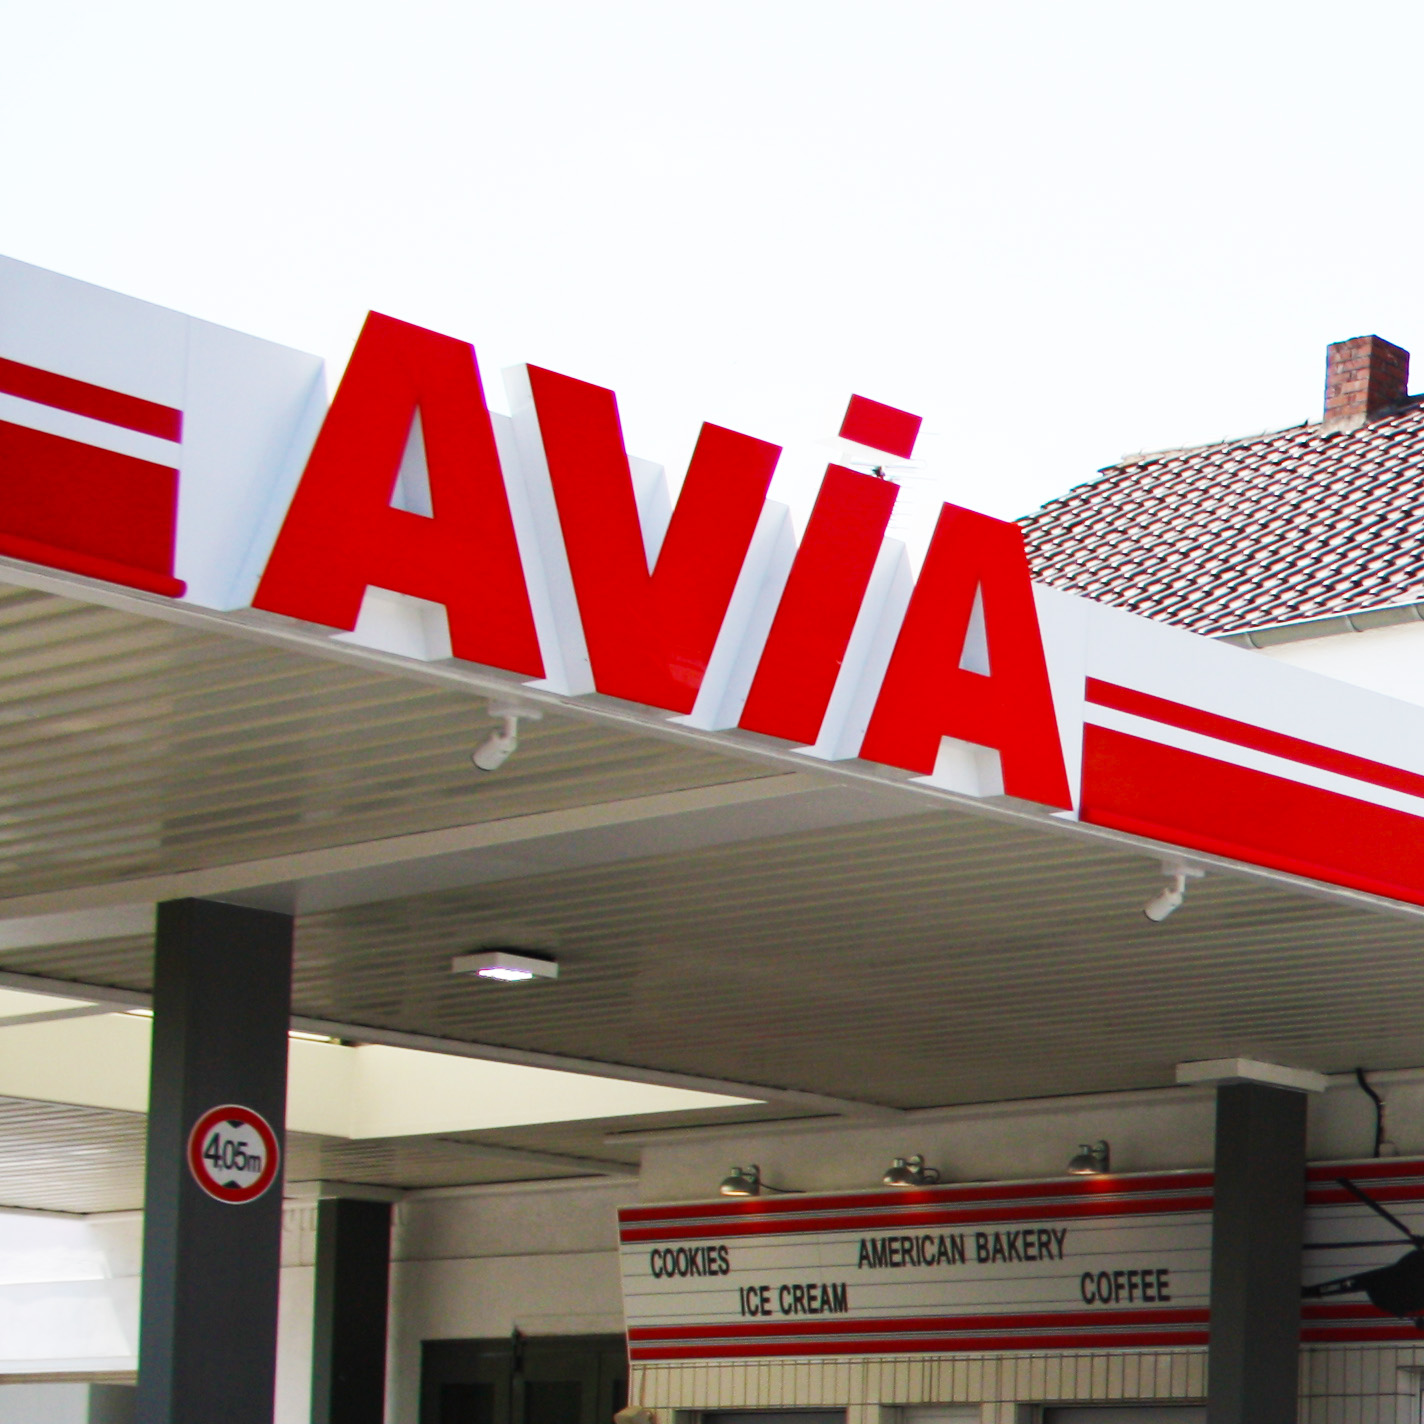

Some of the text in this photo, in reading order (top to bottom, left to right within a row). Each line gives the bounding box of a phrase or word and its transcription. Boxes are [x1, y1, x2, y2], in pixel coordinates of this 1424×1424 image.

[650, 1244, 731, 1279] COOKIES
[858, 1228, 1068, 1269] AMERICAN BAKERY
[739, 1282, 848, 1317] ICE CREAM
[1080, 1268, 1171, 1306] COFFEE
